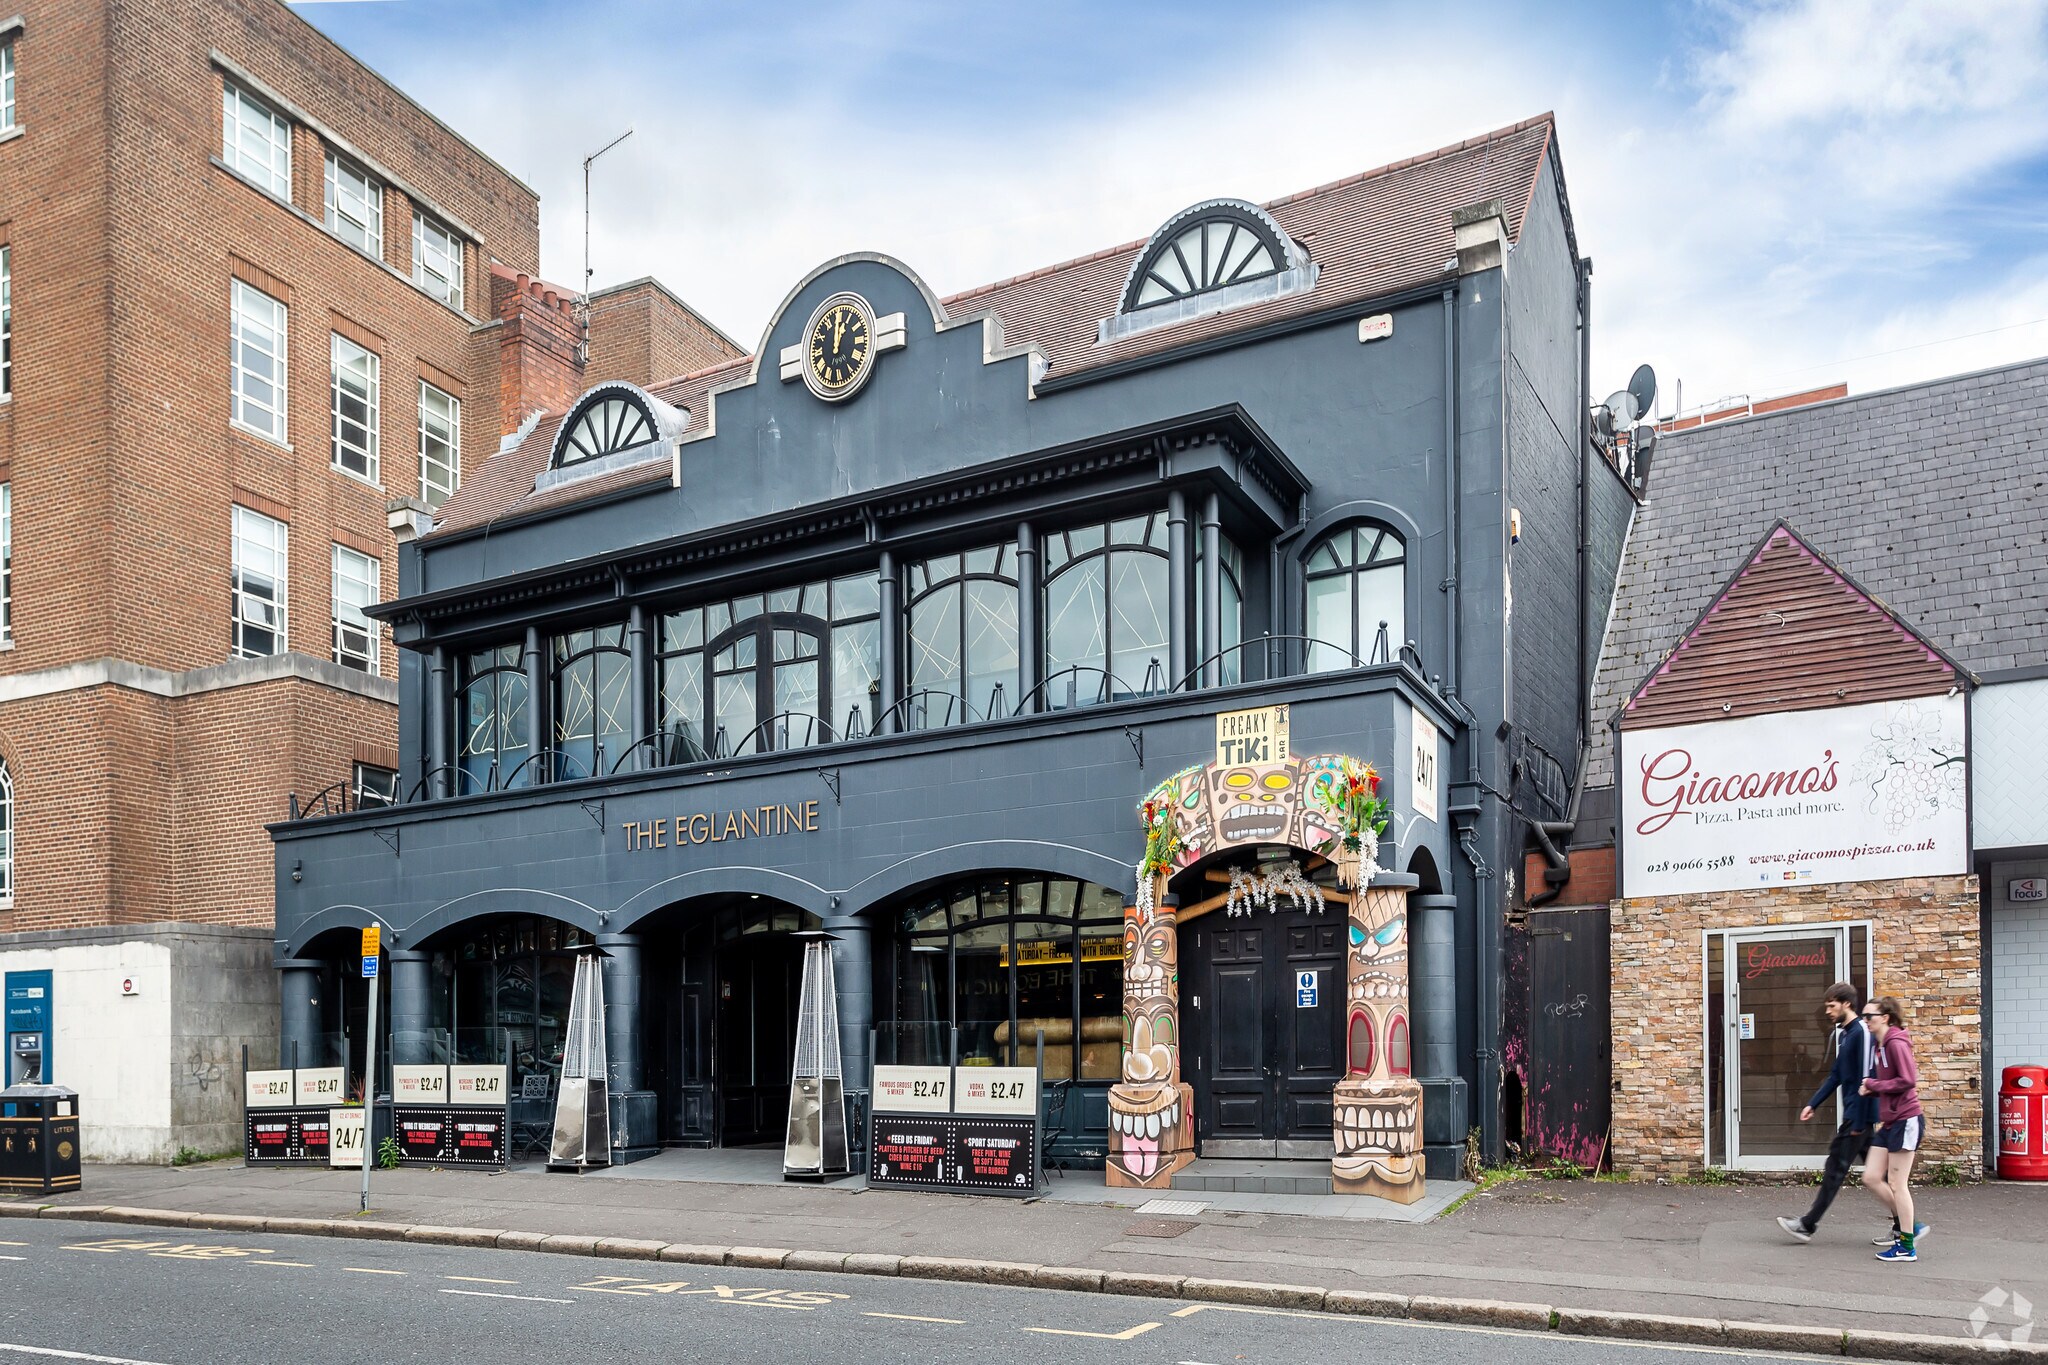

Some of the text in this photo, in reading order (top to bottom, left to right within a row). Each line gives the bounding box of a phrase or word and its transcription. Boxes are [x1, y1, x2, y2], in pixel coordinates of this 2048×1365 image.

[1223, 712, 1267, 736] FREAKY
[1417, 746, 1432, 790] 24/7
[1636, 748, 1839, 835] Giacomo's
[1738, 807, 1773, 821] Pasta
[1777, 803, 1801, 815] and
[1806, 802, 1844, 813] more.
[623, 800, 819, 851] THE EGLANTINE
[1749, 838, 1935, 865] www.giacomospizza.co.uk
[1648, 855, 1735, 874] 028 9066 5588
[2015, 889, 2042, 898] focus
[1082, 945, 1096, 956] WITH
[1100, 944, 1123, 956] BURGER
[1746, 944, 1826, 979] Giacomo's
[269, 1082, 288, 1094] £2.47
[318, 1080, 338, 1092] £2.47
[421, 1078, 442, 1090] £2.47
[476, 1078, 499, 1091] £2.47
[914, 1081, 945, 1097] £2.47
[991, 1082, 1024, 1099] £2.47
[337, 1128, 364, 1148] 24/7
[891, 1135, 933, 1145] FEED US FRIDAY
[968, 1137, 1016, 1148] SPORT SATURDAY
[879, 1145, 898, 1153] PLATTER
[903, 1146, 922, 1154] PITCHER
[998, 1150, 1011, 1158] WINE
[910, 1154, 927, 1162] BOTTLE
[973, 1157, 980, 1165] OR
[994, 1158, 1009, 1166] DRINK
[975, 1166, 1008, 1175] WITH BURGER
[579, 1275, 850, 1305] TAXIS
